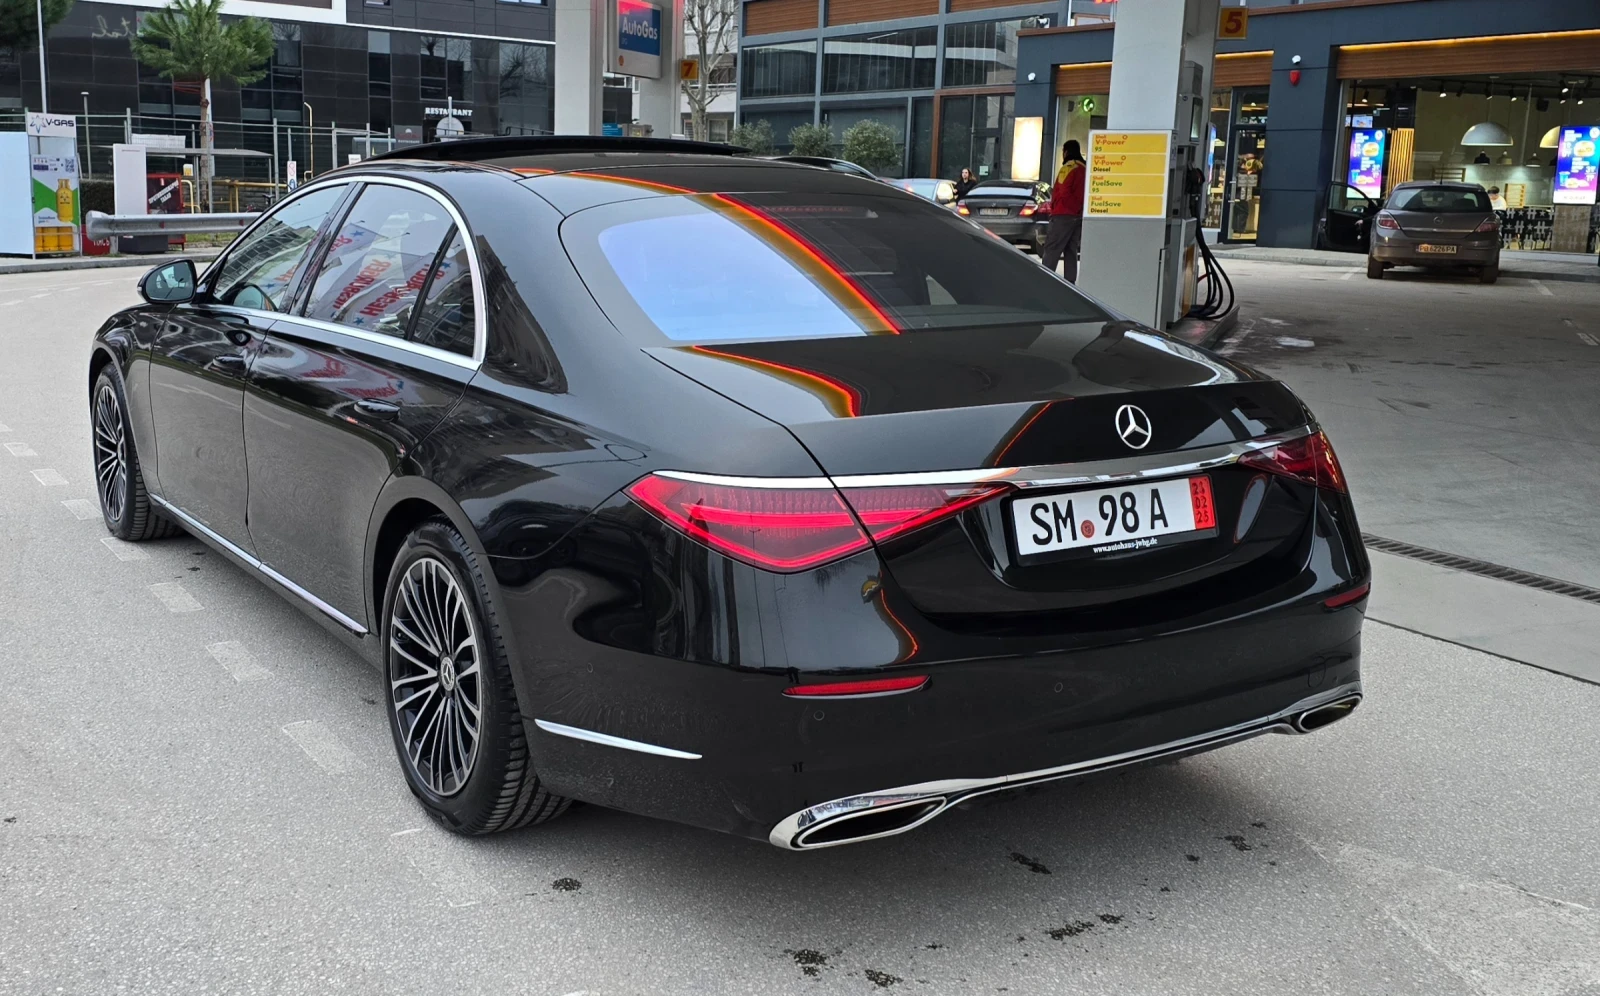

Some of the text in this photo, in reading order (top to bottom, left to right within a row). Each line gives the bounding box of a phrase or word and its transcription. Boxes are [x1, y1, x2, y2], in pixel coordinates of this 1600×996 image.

[622, 17, 658, 40] AutoGas
[1225, 11, 1243, 34] 5
[683, 62, 694, 77] 7
[46, 118, 75, 127] V-GAS
[1194, 495, 1208, 509] 02
[1030, 488, 1169, 546] SM 98 A
[1196, 510, 1210, 524] 25
